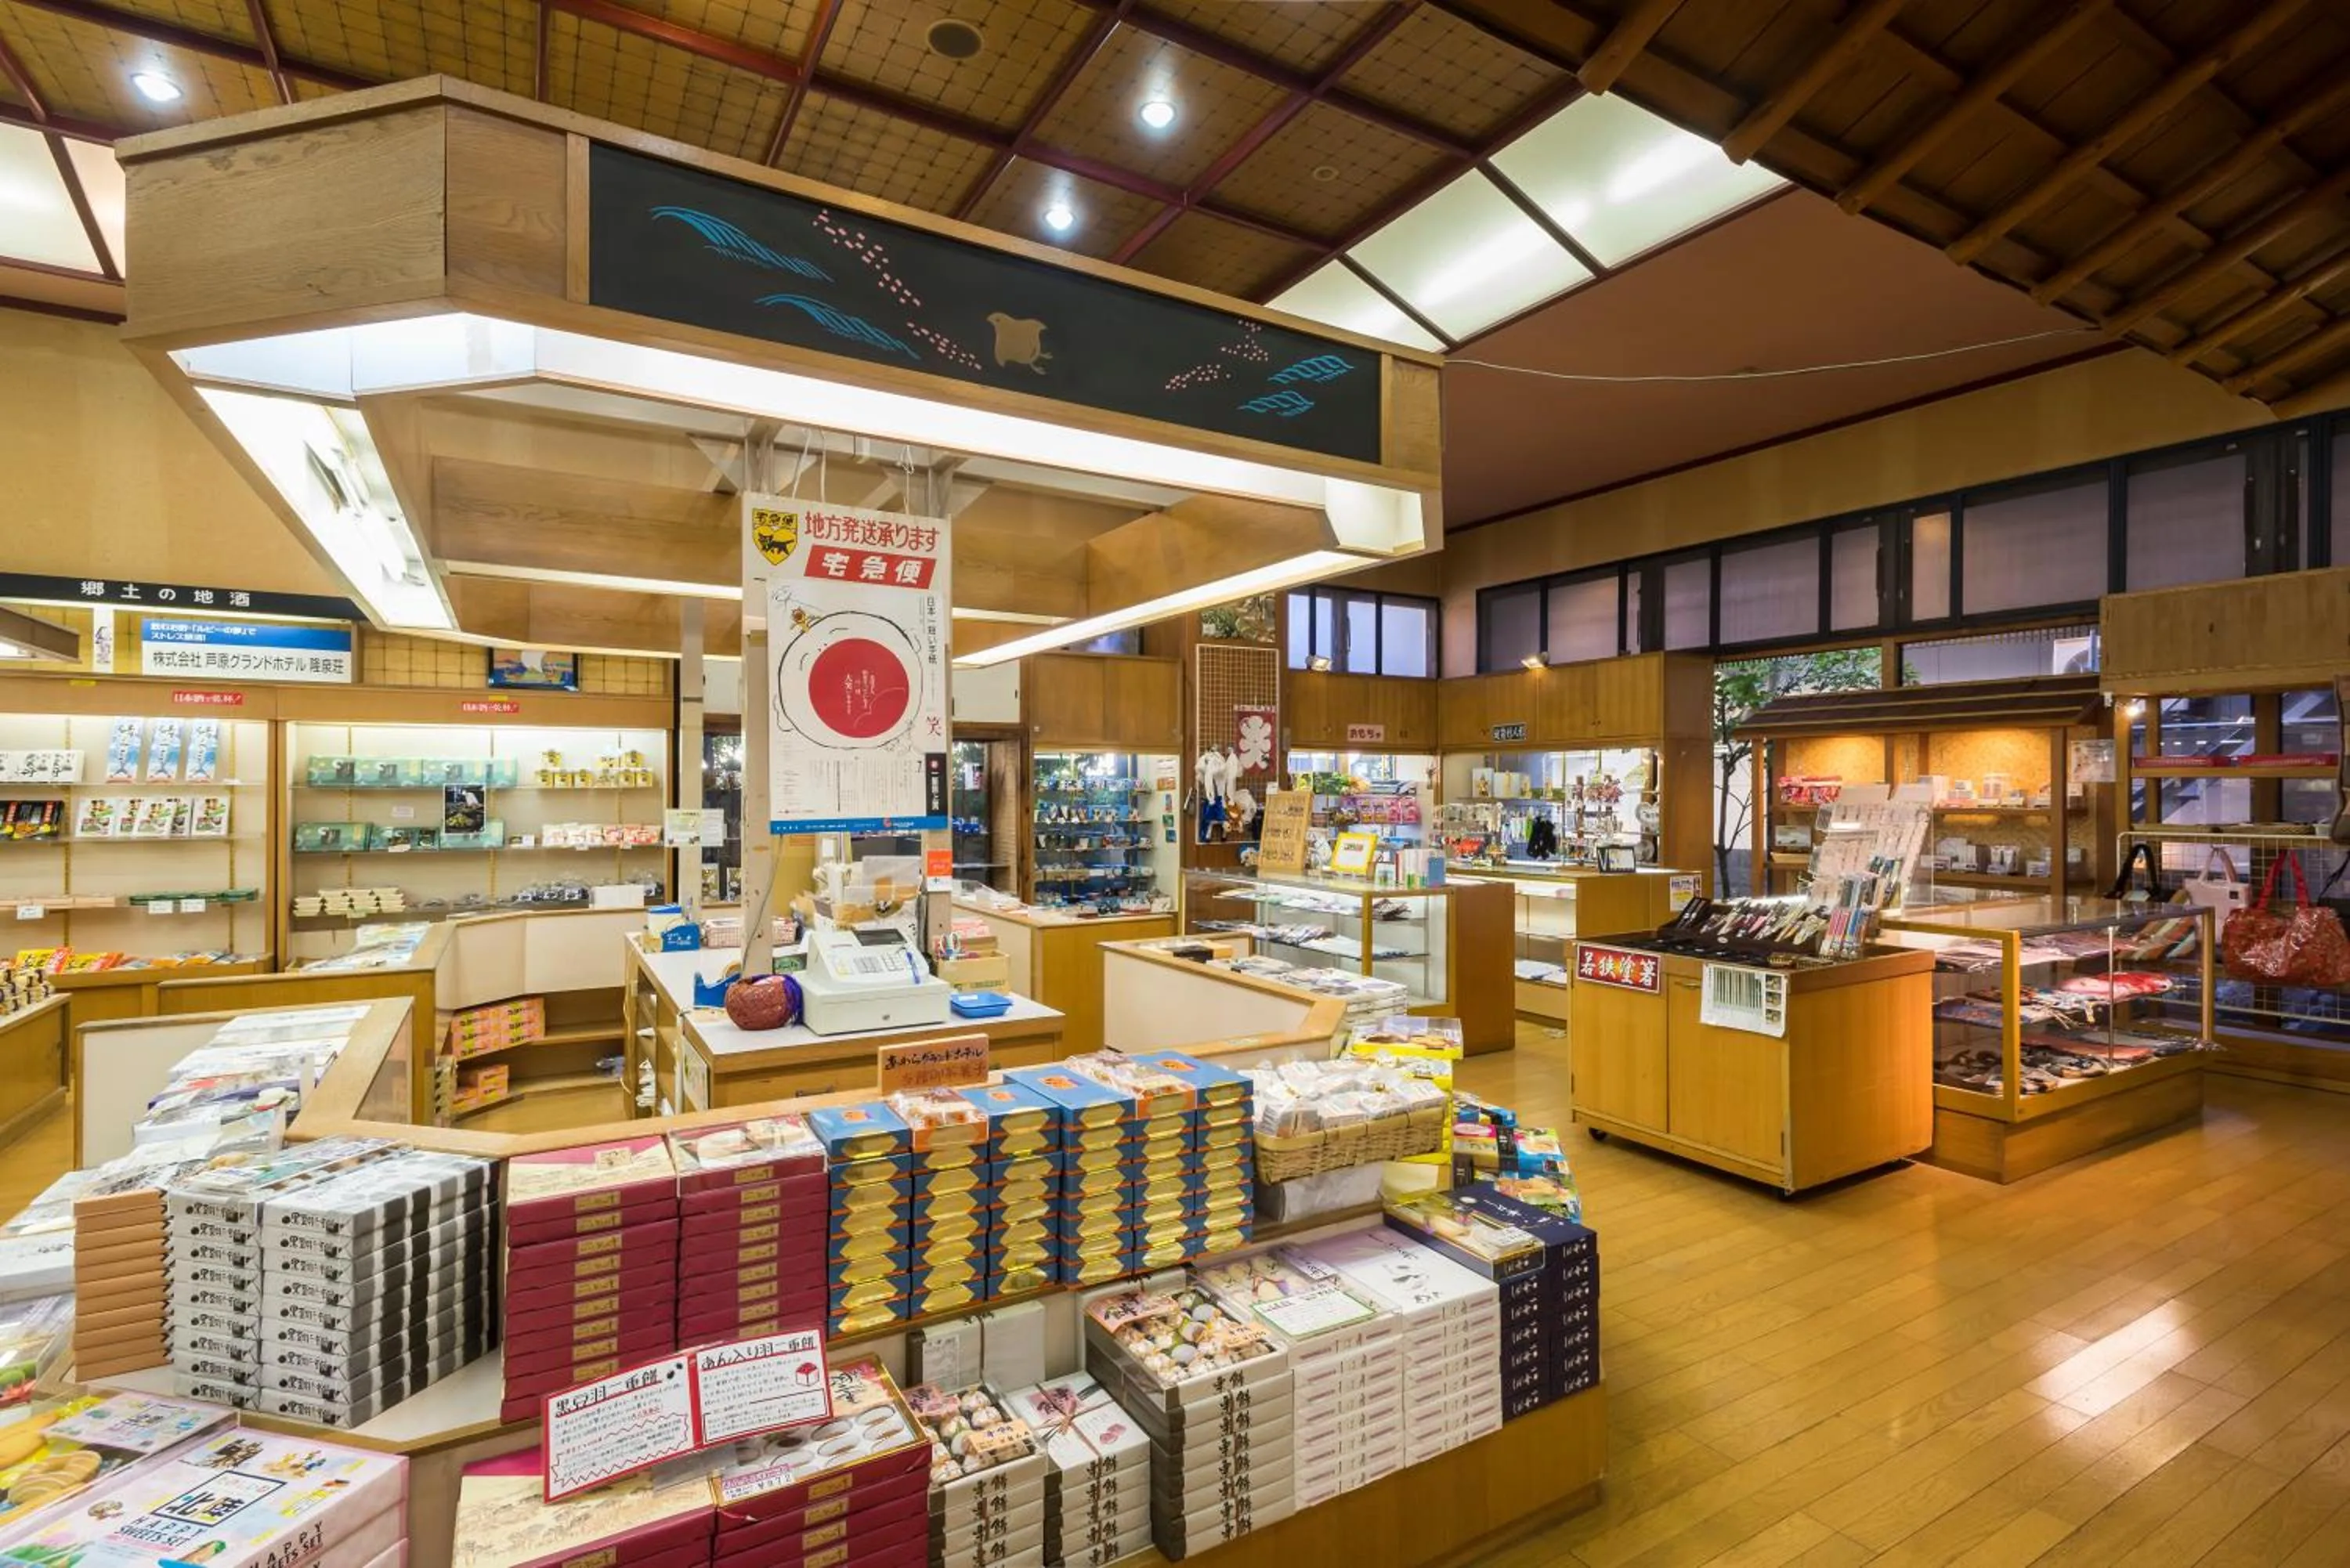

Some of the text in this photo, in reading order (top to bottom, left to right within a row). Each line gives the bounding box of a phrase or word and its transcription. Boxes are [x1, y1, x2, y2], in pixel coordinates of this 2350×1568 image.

[804, 511, 940, 551] 地方発送承ります
[822, 552, 924, 583] 宅急便
[81, 580, 251, 608] 郷土の地酒
[154, 651, 345, 674] 株式会社 芦原グランドホテル 隆泉荘
[1350, 728, 1381, 739] おもちゃ
[1580, 951, 1656, 987] 若狭塗箸
[701, 1335, 815, 1370] あん入り羽二重餅
[130, 1516, 208, 1537] HAPPY
